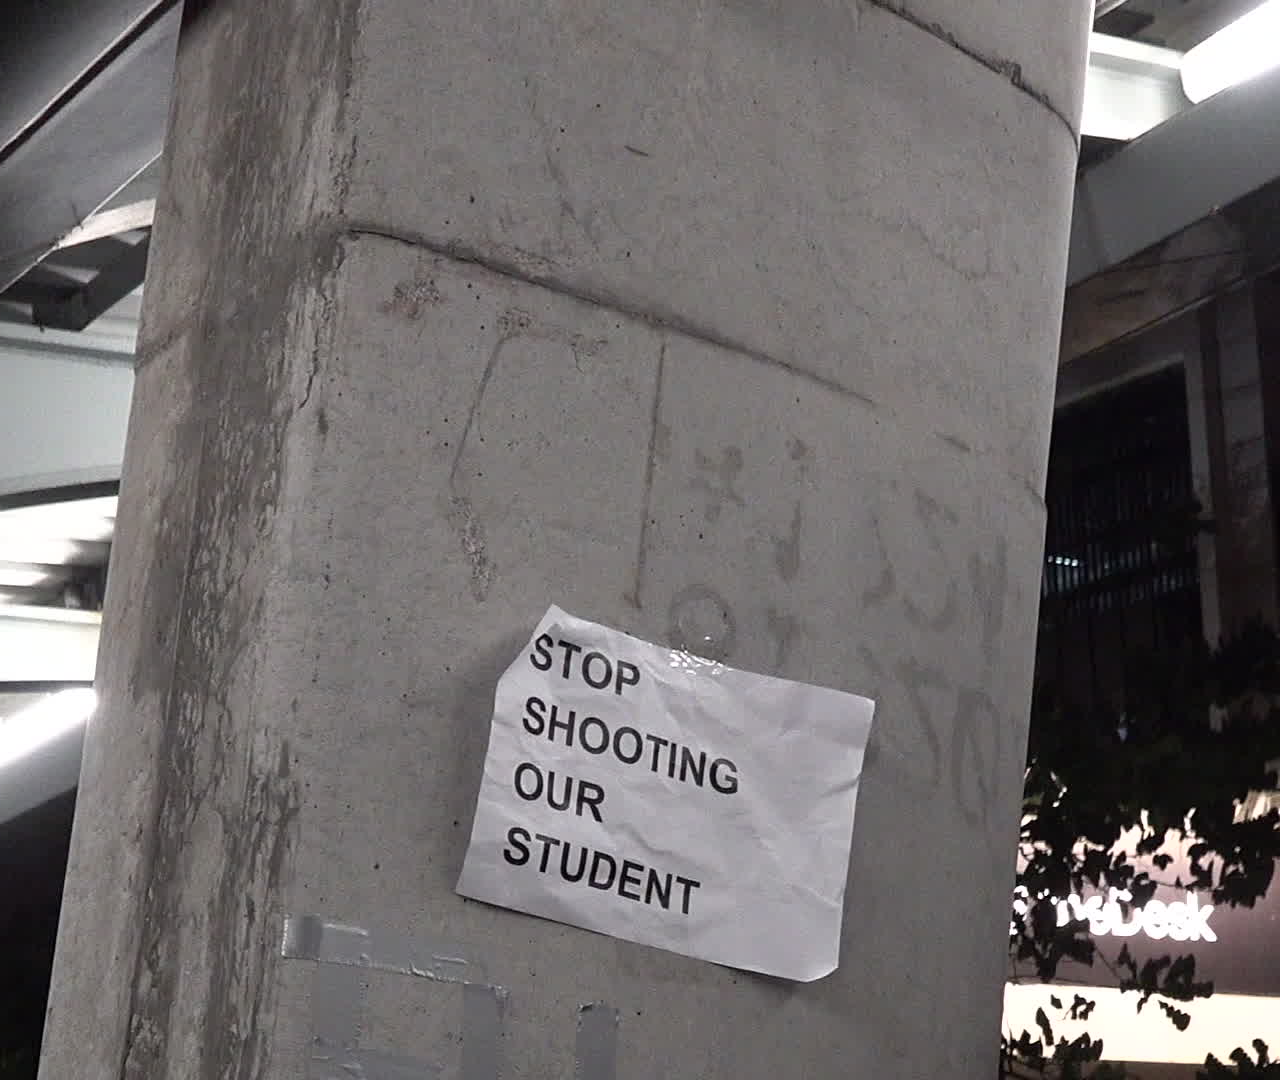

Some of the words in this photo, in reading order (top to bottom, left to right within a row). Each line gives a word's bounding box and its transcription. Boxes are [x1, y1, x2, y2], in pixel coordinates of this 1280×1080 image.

[529, 633, 640, 696] STOP
[522, 696, 739, 795] SHOOTING
[514, 761, 605, 823] OUR
[503, 826, 701, 915] STUDENT
